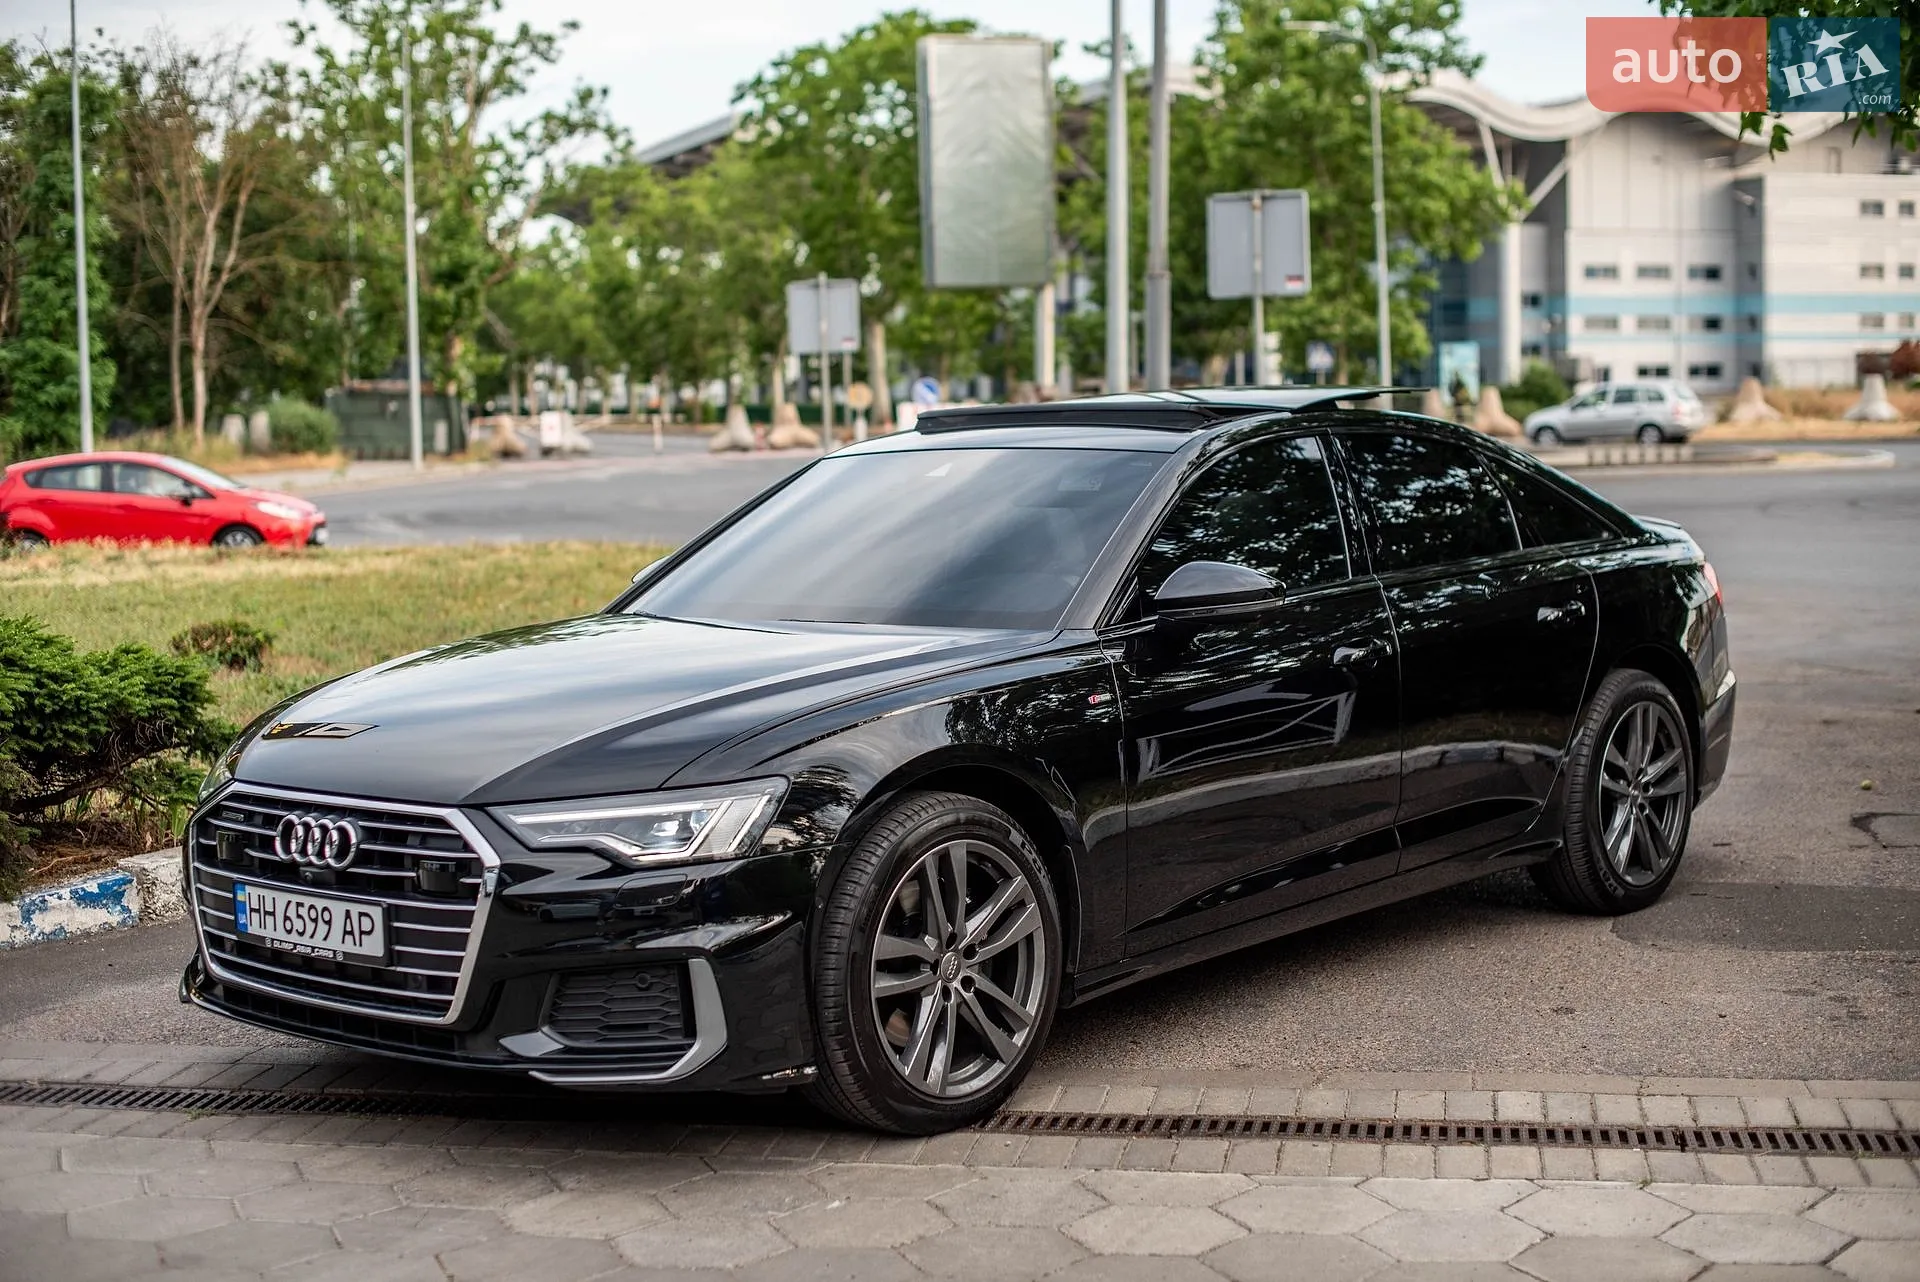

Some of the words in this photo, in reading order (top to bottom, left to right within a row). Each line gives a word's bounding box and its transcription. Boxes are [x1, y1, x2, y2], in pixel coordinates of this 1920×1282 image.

[248, 892, 277, 932] HH
[283, 900, 333, 941] 6599
[341, 909, 375, 947] AP
